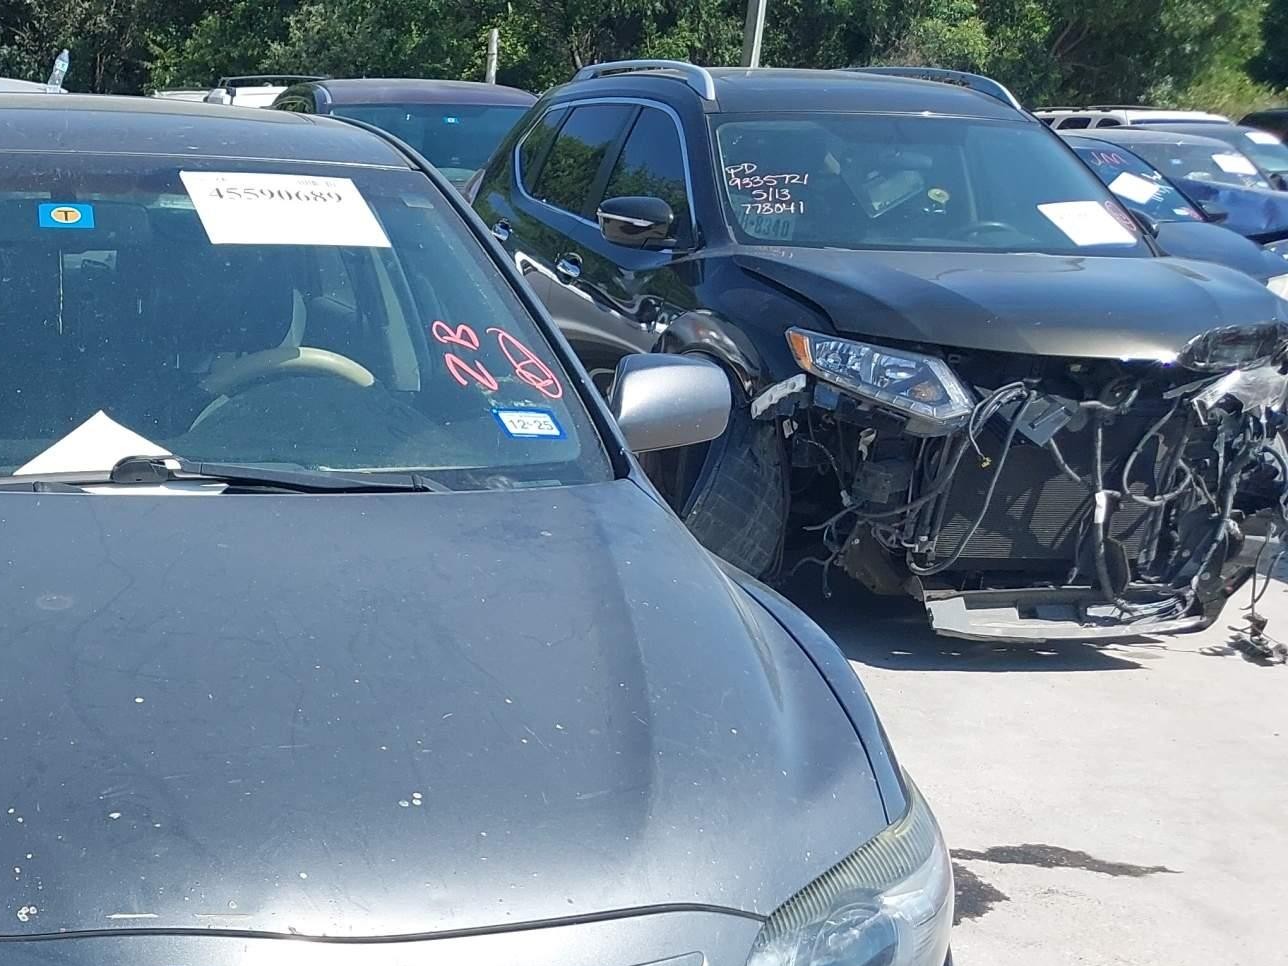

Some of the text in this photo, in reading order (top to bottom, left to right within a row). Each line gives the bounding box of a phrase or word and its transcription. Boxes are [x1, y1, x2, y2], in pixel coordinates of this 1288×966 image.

[729, 174, 808, 189] 9335721
[752, 187, 791, 201] 5/13
[741, 201, 804, 215] 778041
[57, 210, 75, 222] T
